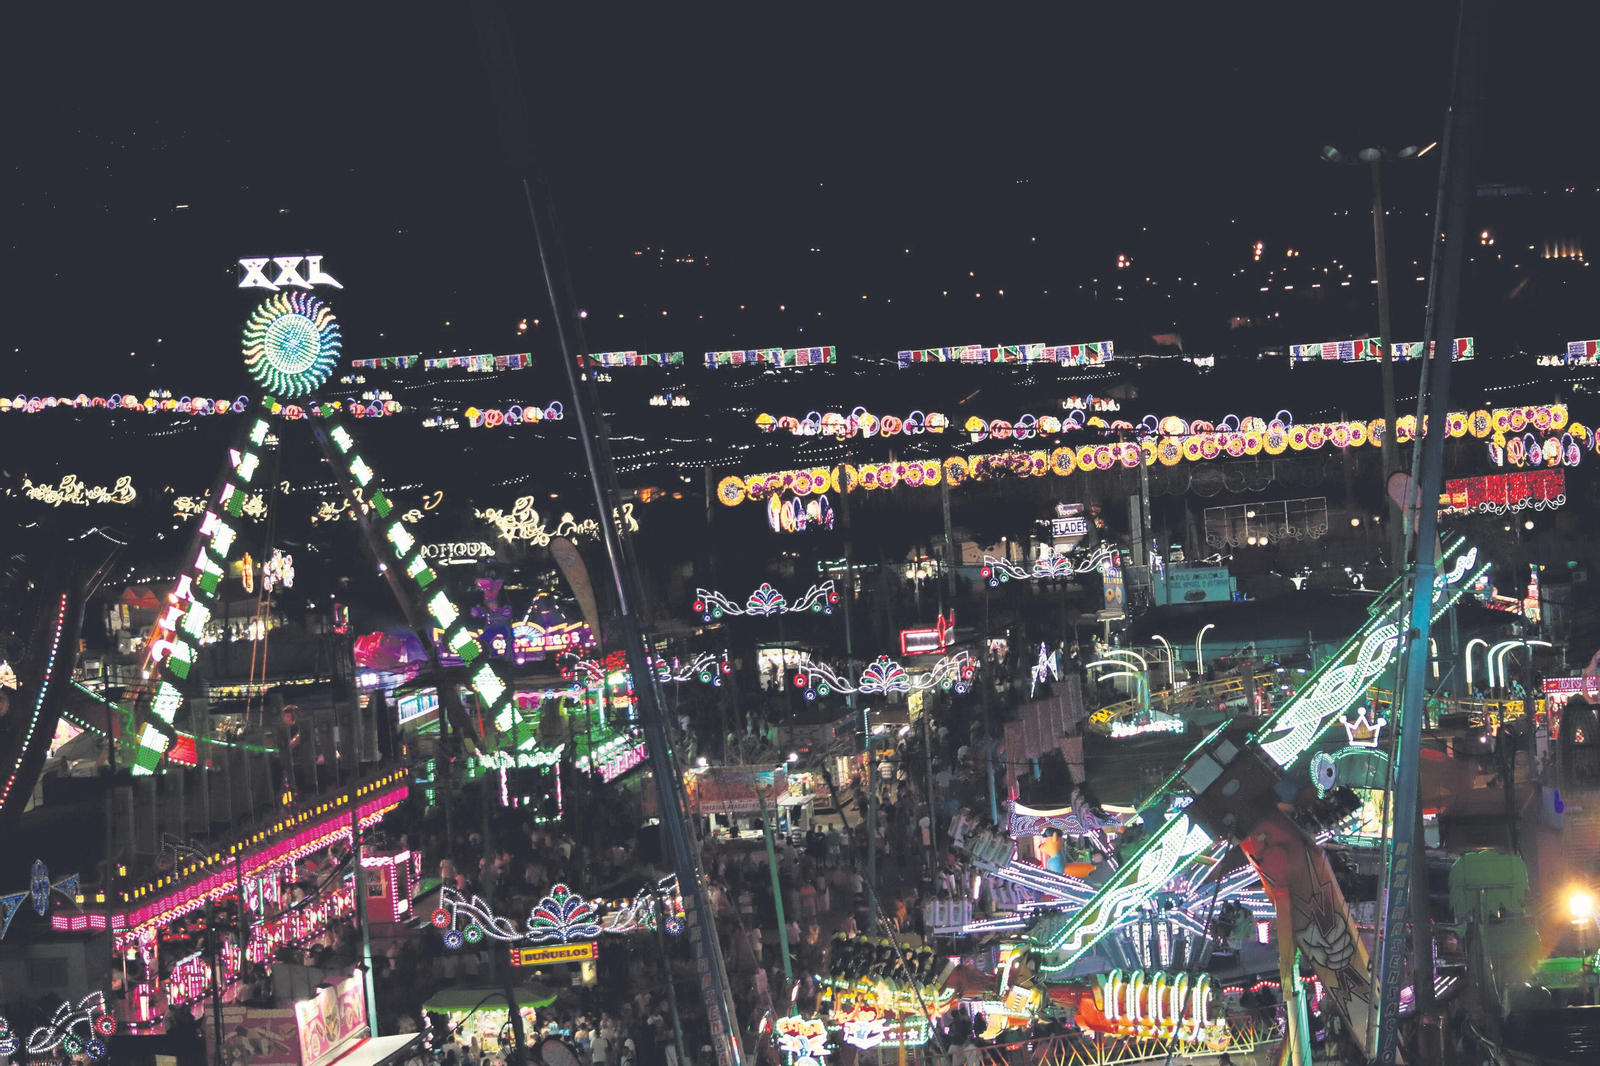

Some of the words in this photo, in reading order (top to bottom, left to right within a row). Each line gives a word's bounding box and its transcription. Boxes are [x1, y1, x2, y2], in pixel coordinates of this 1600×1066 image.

[239, 255, 344, 291] XXL
[530, 632, 580, 647] JUEGOS
[524, 946, 589, 962] BUÑUELOS
